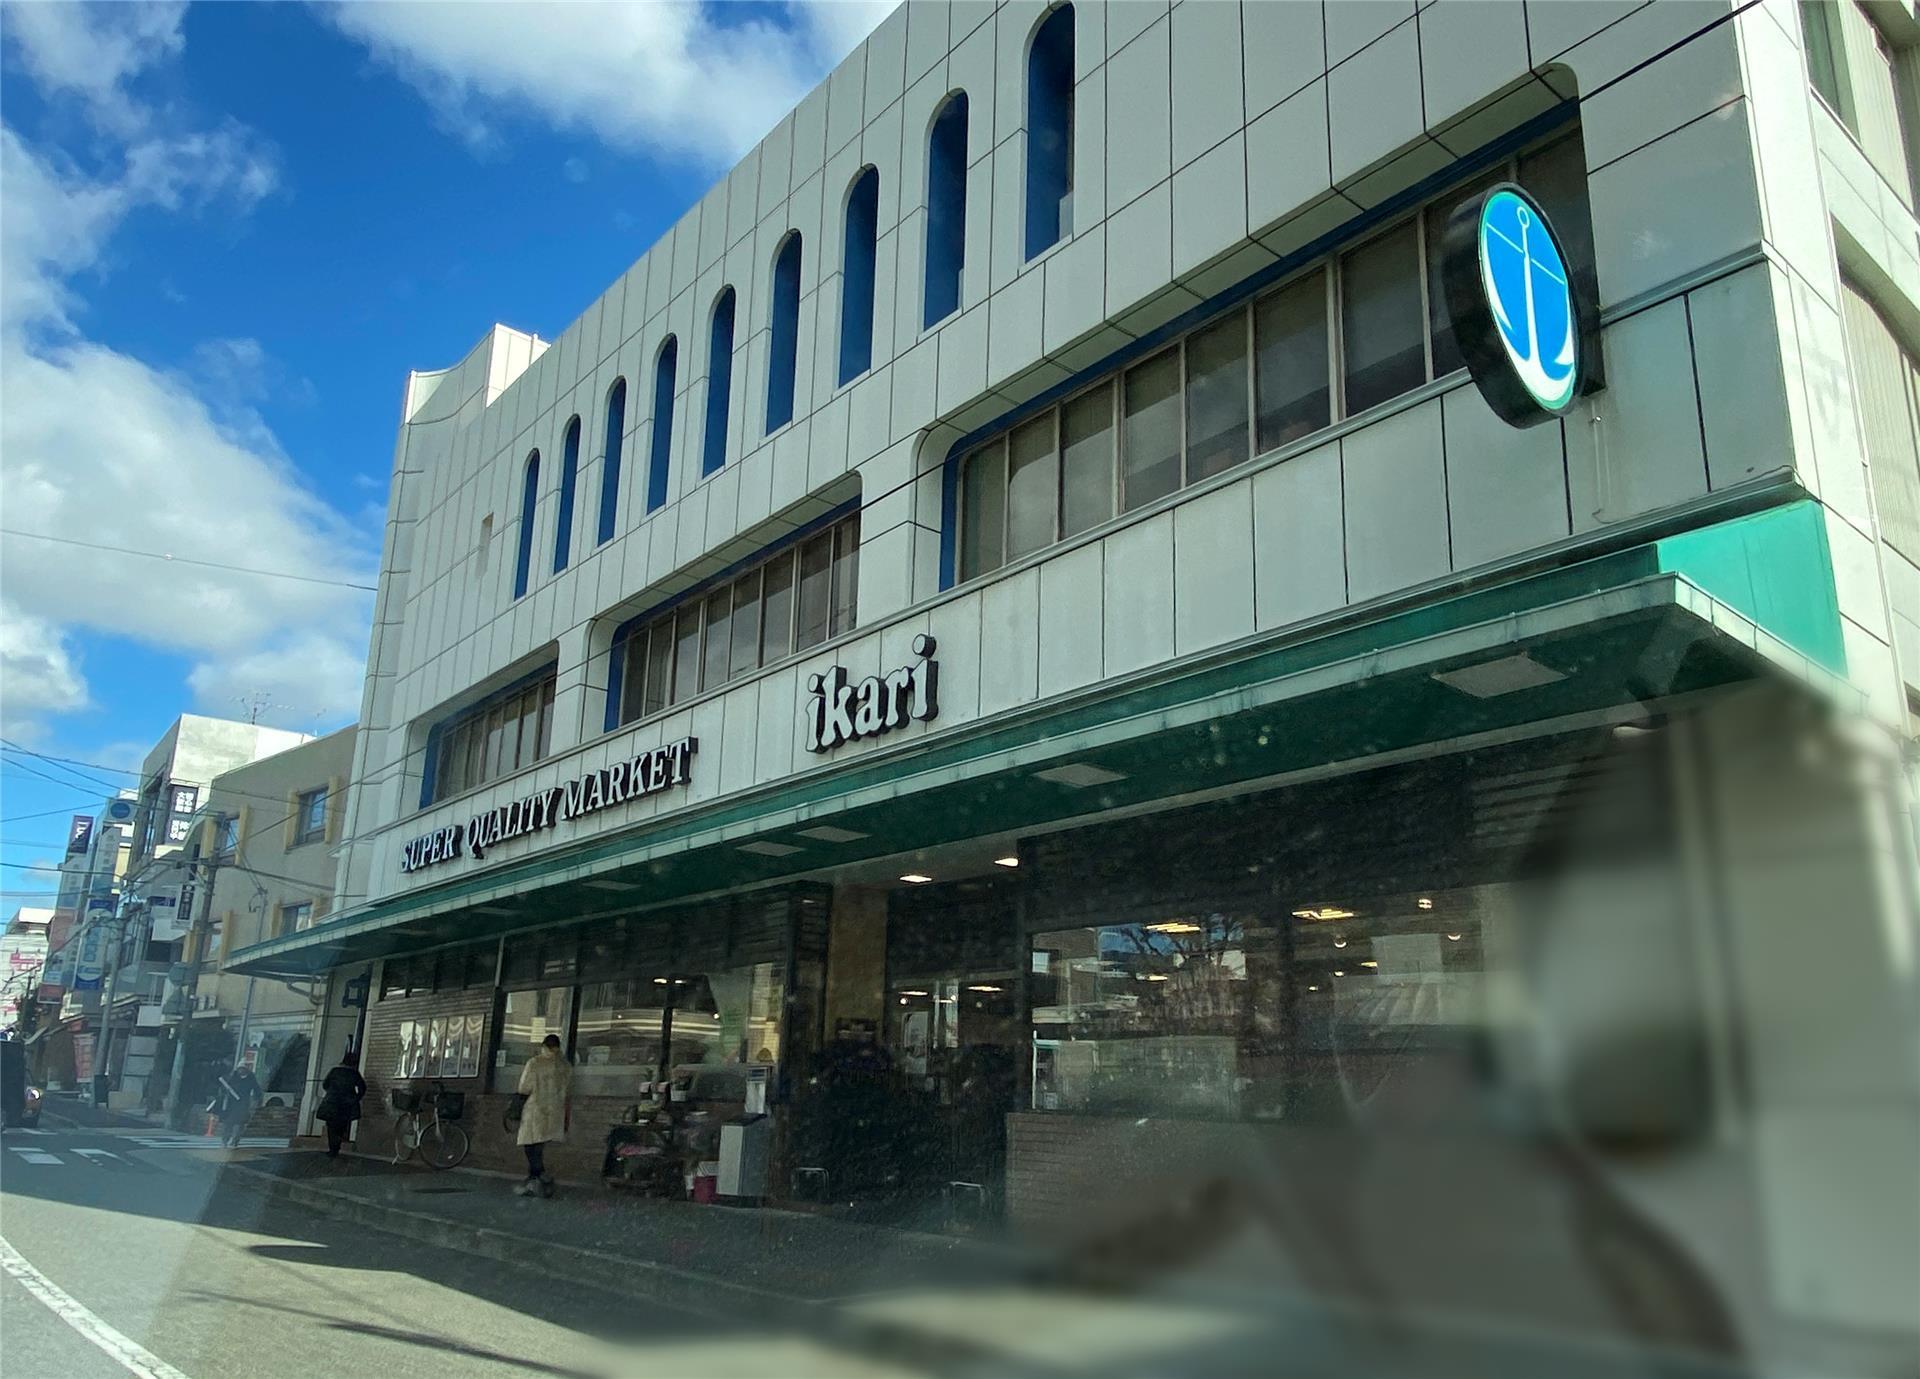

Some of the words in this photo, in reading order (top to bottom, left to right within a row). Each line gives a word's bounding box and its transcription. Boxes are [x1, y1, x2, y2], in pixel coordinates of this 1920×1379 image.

[805, 633, 939, 754] ikari
[401, 824, 463, 873] SUPER
[467, 787, 564, 860] QUALITY
[561, 736, 698, 821] MARKET
